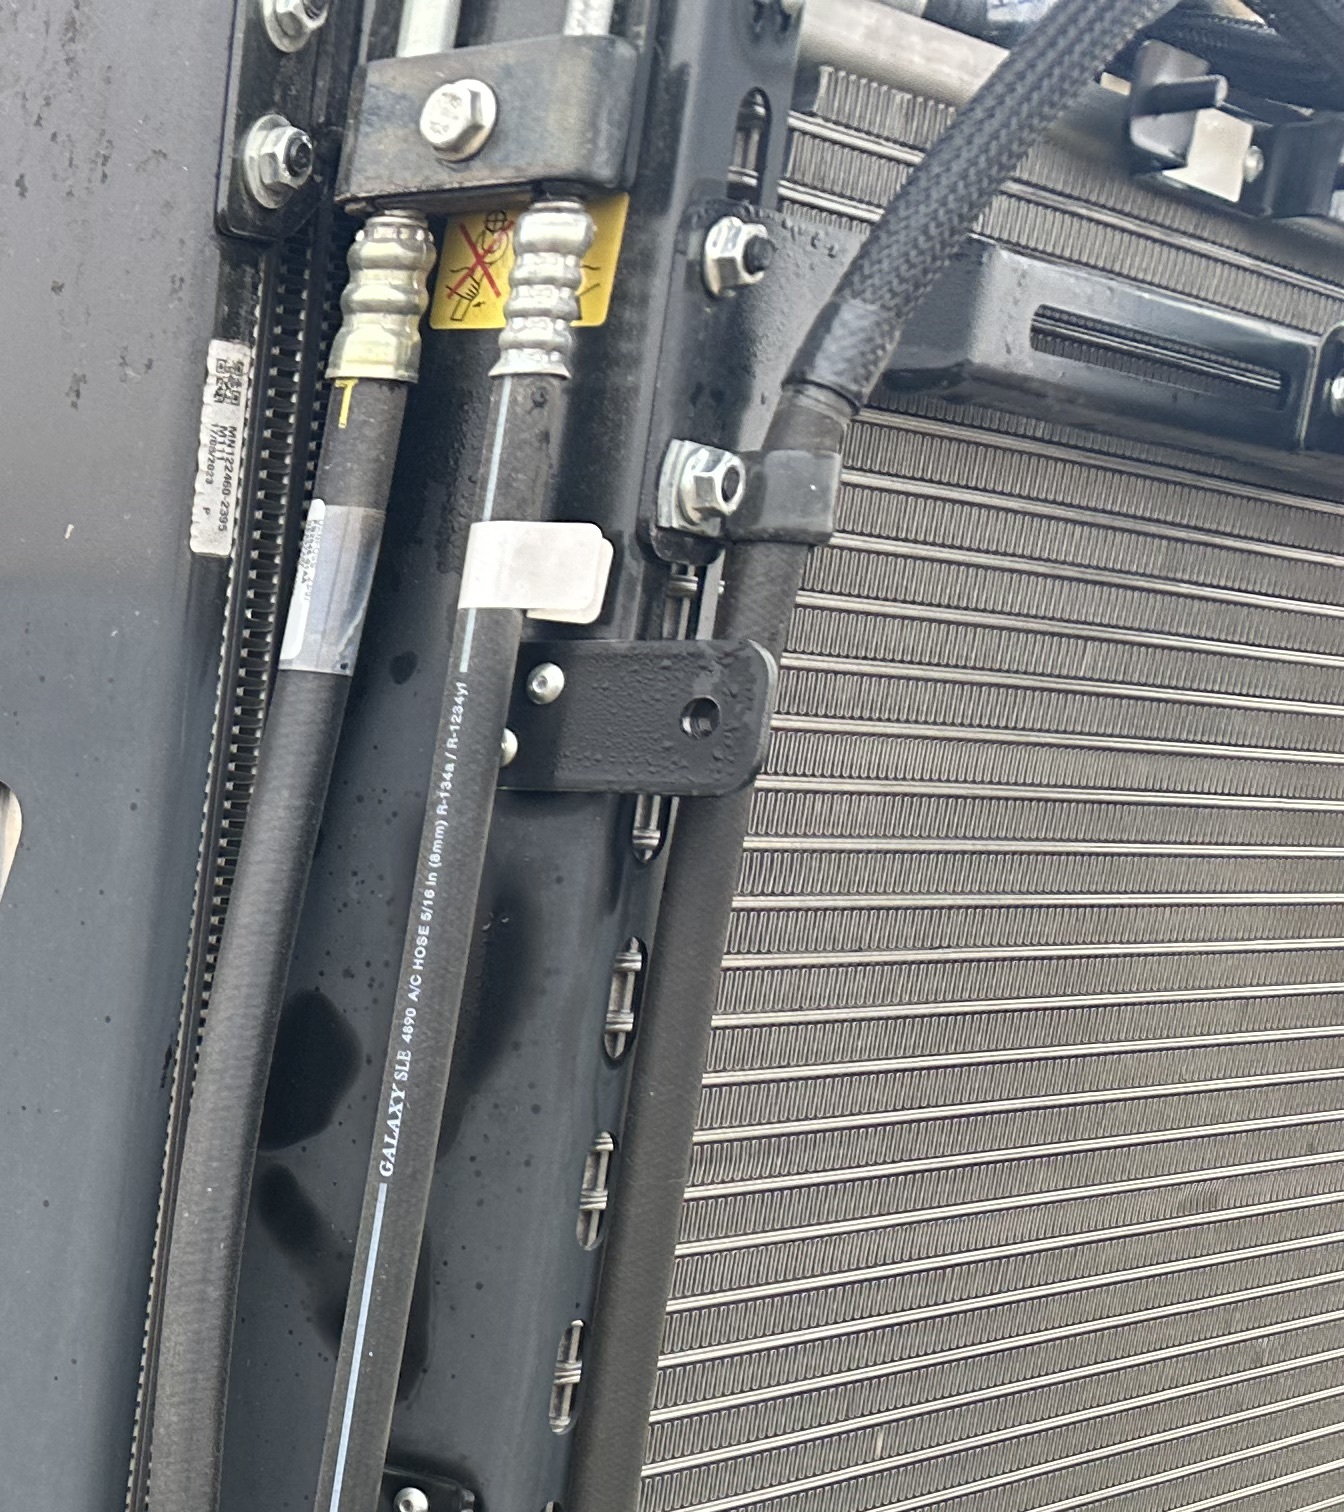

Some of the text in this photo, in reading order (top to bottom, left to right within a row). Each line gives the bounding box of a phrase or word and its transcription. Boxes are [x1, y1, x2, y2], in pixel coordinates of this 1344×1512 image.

[435, 763, 456, 816] R-134a
[428, 818, 449, 869] (8mm)
[420, 888, 436, 922] 5/16
[412, 924, 430, 970] HOSE
[407, 974, 422, 1003] A/C
[401, 1007, 417, 1044] 4890
[393, 1049, 412, 1082] SLE
[379, 1082, 406, 1178] GALAXY
